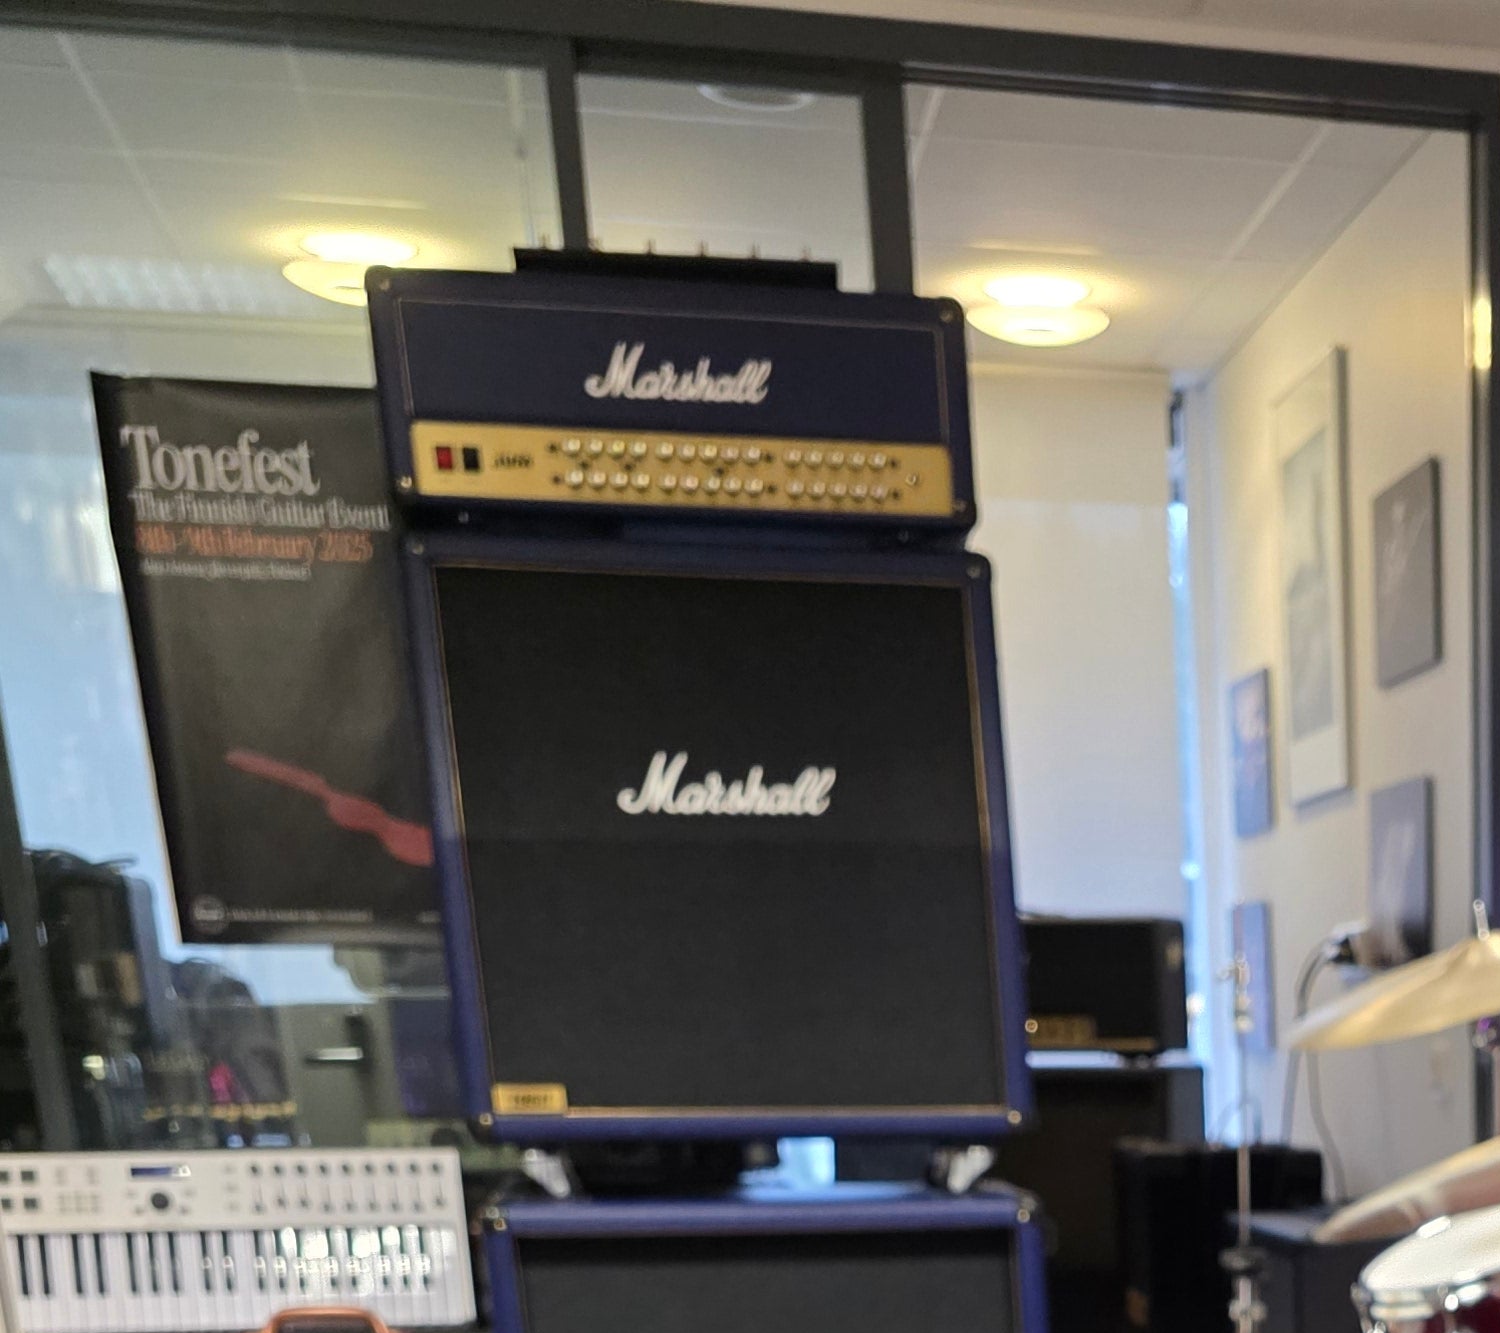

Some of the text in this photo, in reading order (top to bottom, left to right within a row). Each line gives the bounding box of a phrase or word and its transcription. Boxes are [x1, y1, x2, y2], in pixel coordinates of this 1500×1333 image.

[583, 341, 773, 404] Marshall
[119, 424, 321, 496] Tonefest
[616, 750, 837, 815] Marshall
